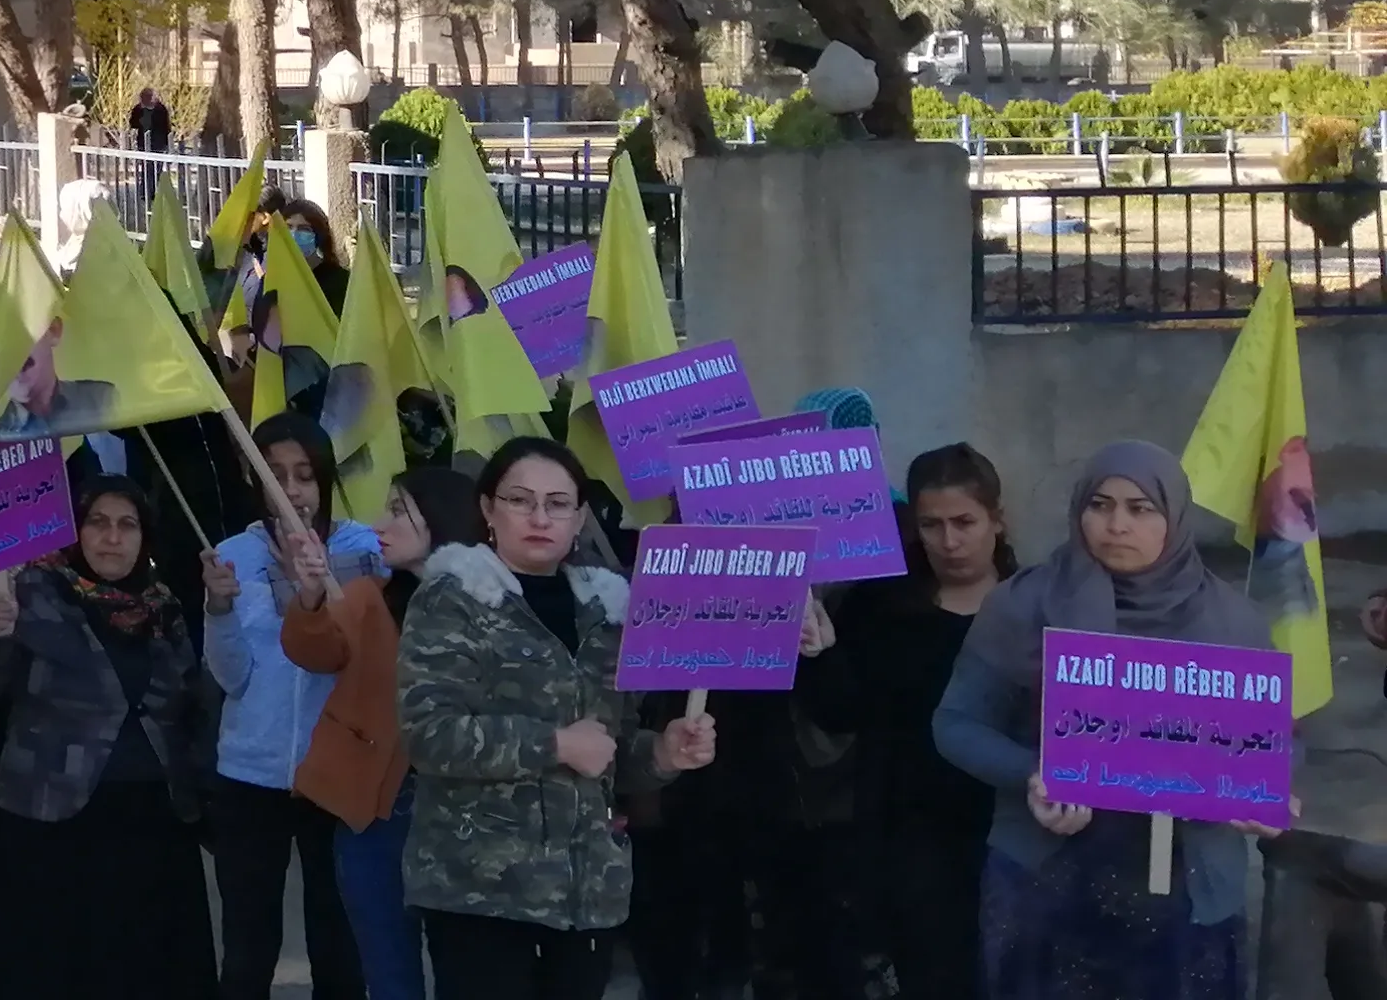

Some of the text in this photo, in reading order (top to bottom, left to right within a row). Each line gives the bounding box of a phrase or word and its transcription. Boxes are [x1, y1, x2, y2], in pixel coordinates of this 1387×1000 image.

[552, 255, 592, 281] ÎMRALI
[599, 354, 737, 408] BIJÎ BERXWEDANA ÎMRALI
[683, 456, 733, 490] AZADÎ
[738, 457, 777, 484] JIBO
[779, 449, 835, 480] RÊBER
[838, 446, 873, 473] APO
[763, 496, 815, 522] للقائد
[817, 489, 885, 523] الحرية
[642, 542, 807, 577] AZADÎ JIBO RÊBER APO
[632, 595, 797, 630] الحرية للقائد اوجلان
[1056, 652, 1282, 704] AZADÎ JIBO RÊBER APO
[1054, 707, 1285, 758] الحرية للقائد اوجلان
